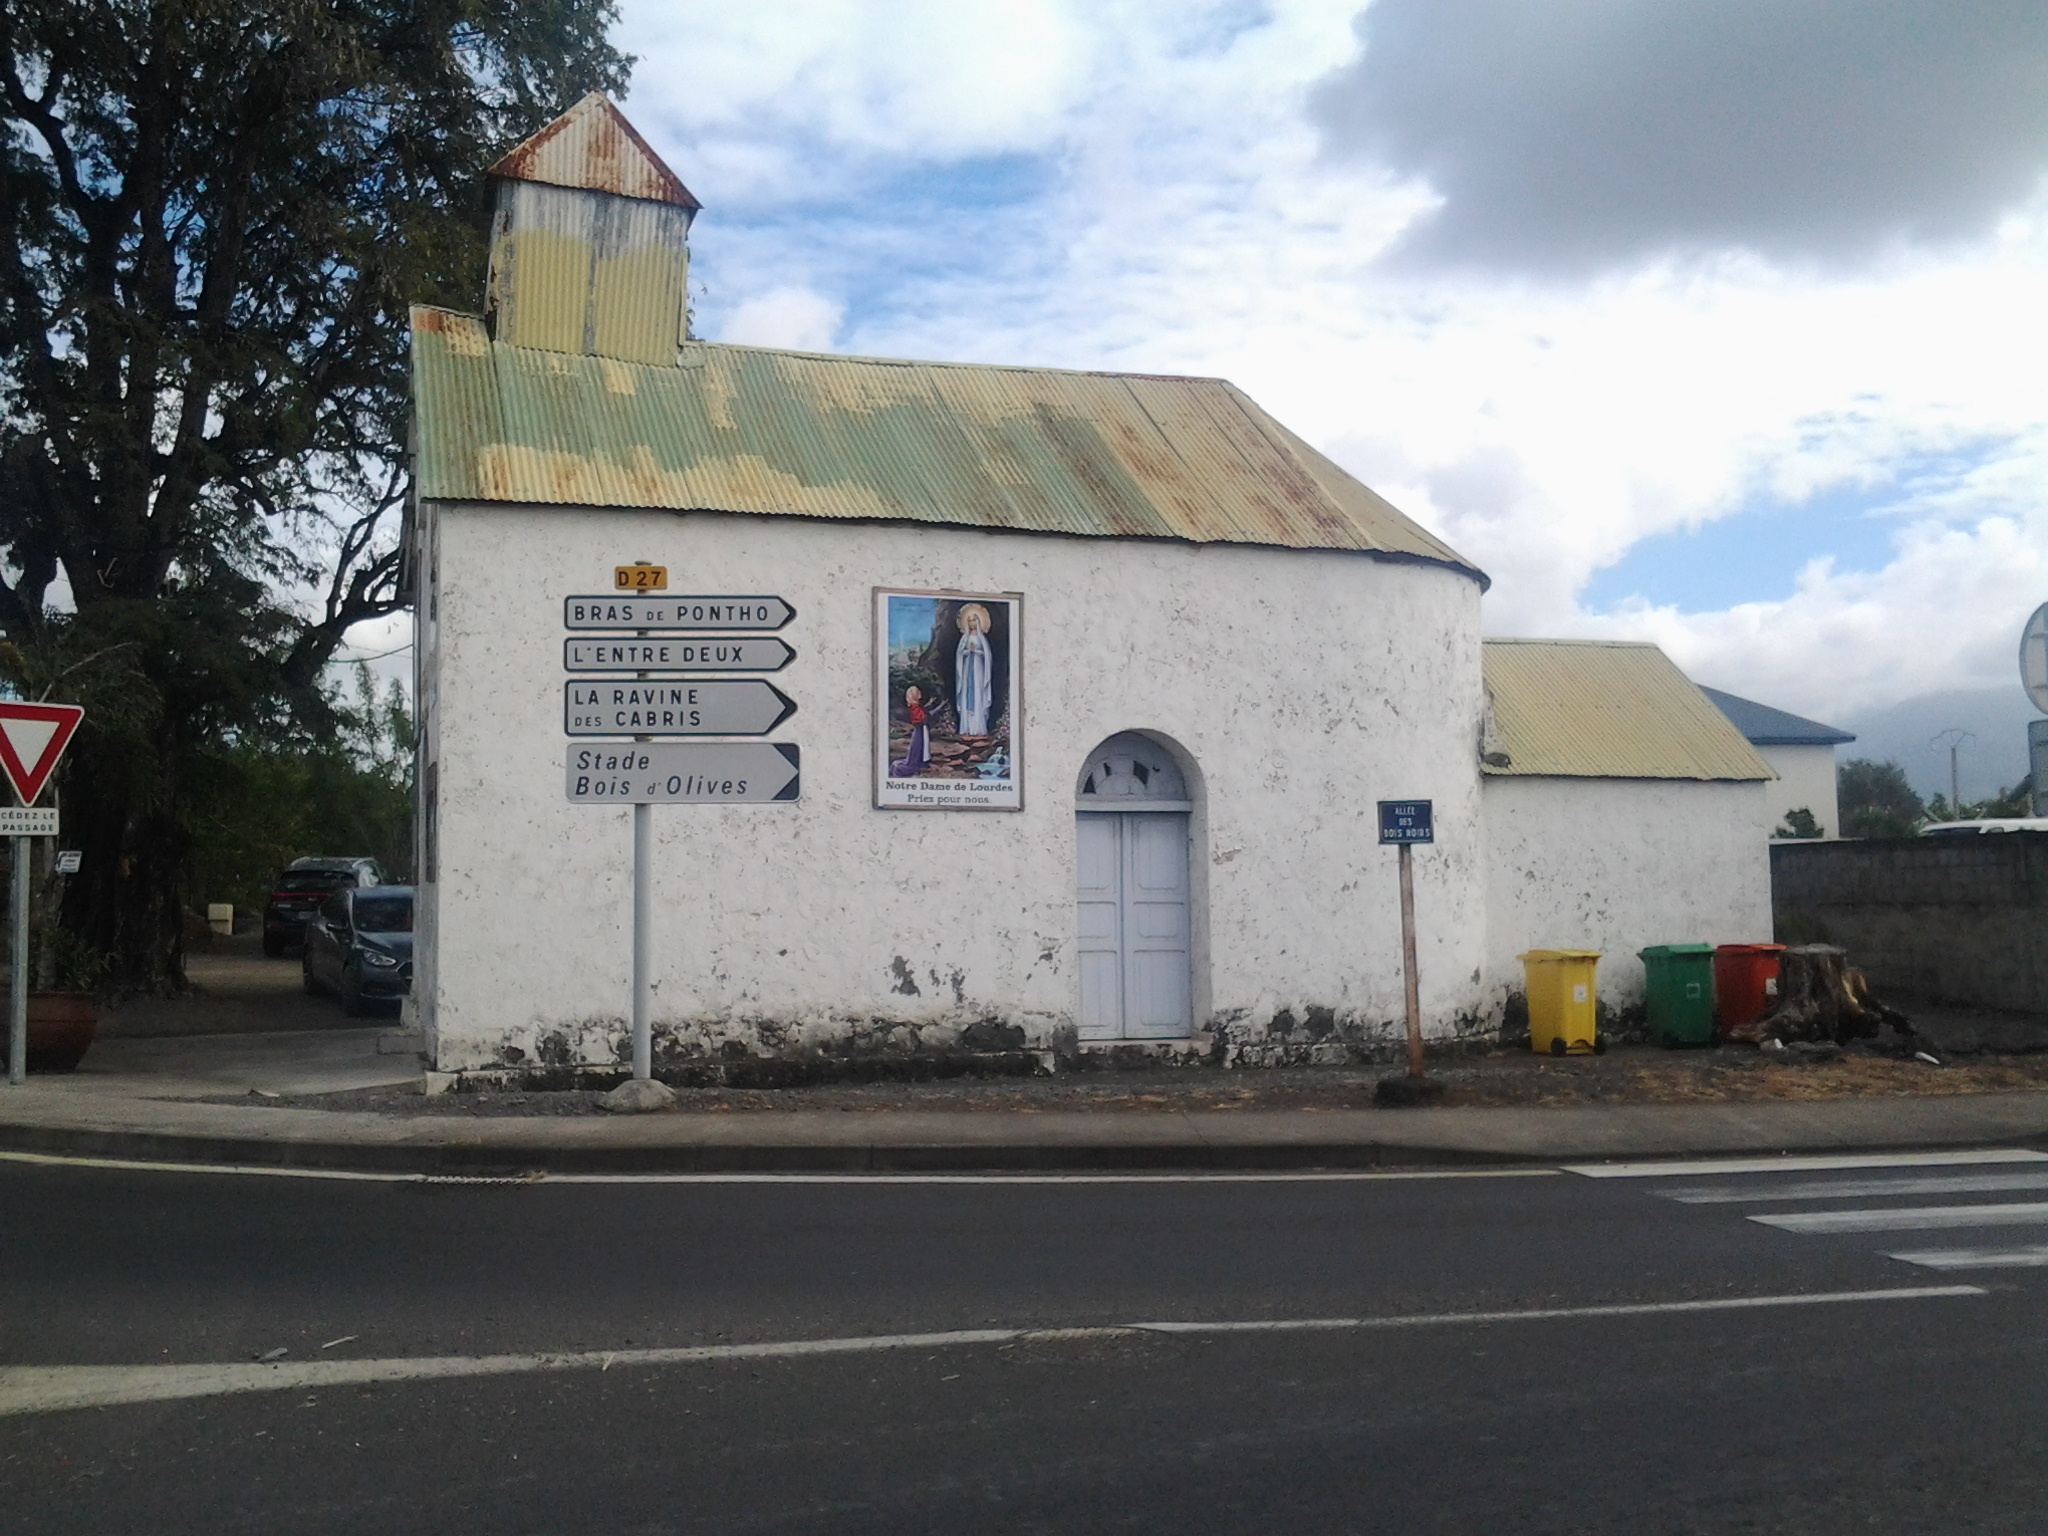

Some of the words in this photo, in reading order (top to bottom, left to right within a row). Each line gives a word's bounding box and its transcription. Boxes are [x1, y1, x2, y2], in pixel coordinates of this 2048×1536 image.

[618, 571, 629, 586] D
[636, 571, 661, 586] 27
[574, 605, 633, 621] BRAS
[646, 611, 664, 621] DE
[677, 605, 768, 621] PONTHO
[574, 647, 670, 662] L'ENTRE
[683, 647, 743, 662] DEUX
[574, 690, 599, 705] LA
[613, 690, 698, 705] RAVINE
[574, 716, 602, 727] DES
[615, 711, 701, 726] CABRIS
[576, 750, 650, 770] Stade
[575, 776, 631, 795] Bois
[885, 781, 917, 790] Notre
[920, 782, 951, 791] Dame
[954, 783, 966, 791] de
[969, 783, 1013, 792] Lourdes
[907, 794, 935, 803] Priez
[937, 796, 962, 805] pour
[1, 810, 38, 820] CÉDEZ
[43, 812, 55, 820] LE
[2, 824, 53, 832] PASSAGE
